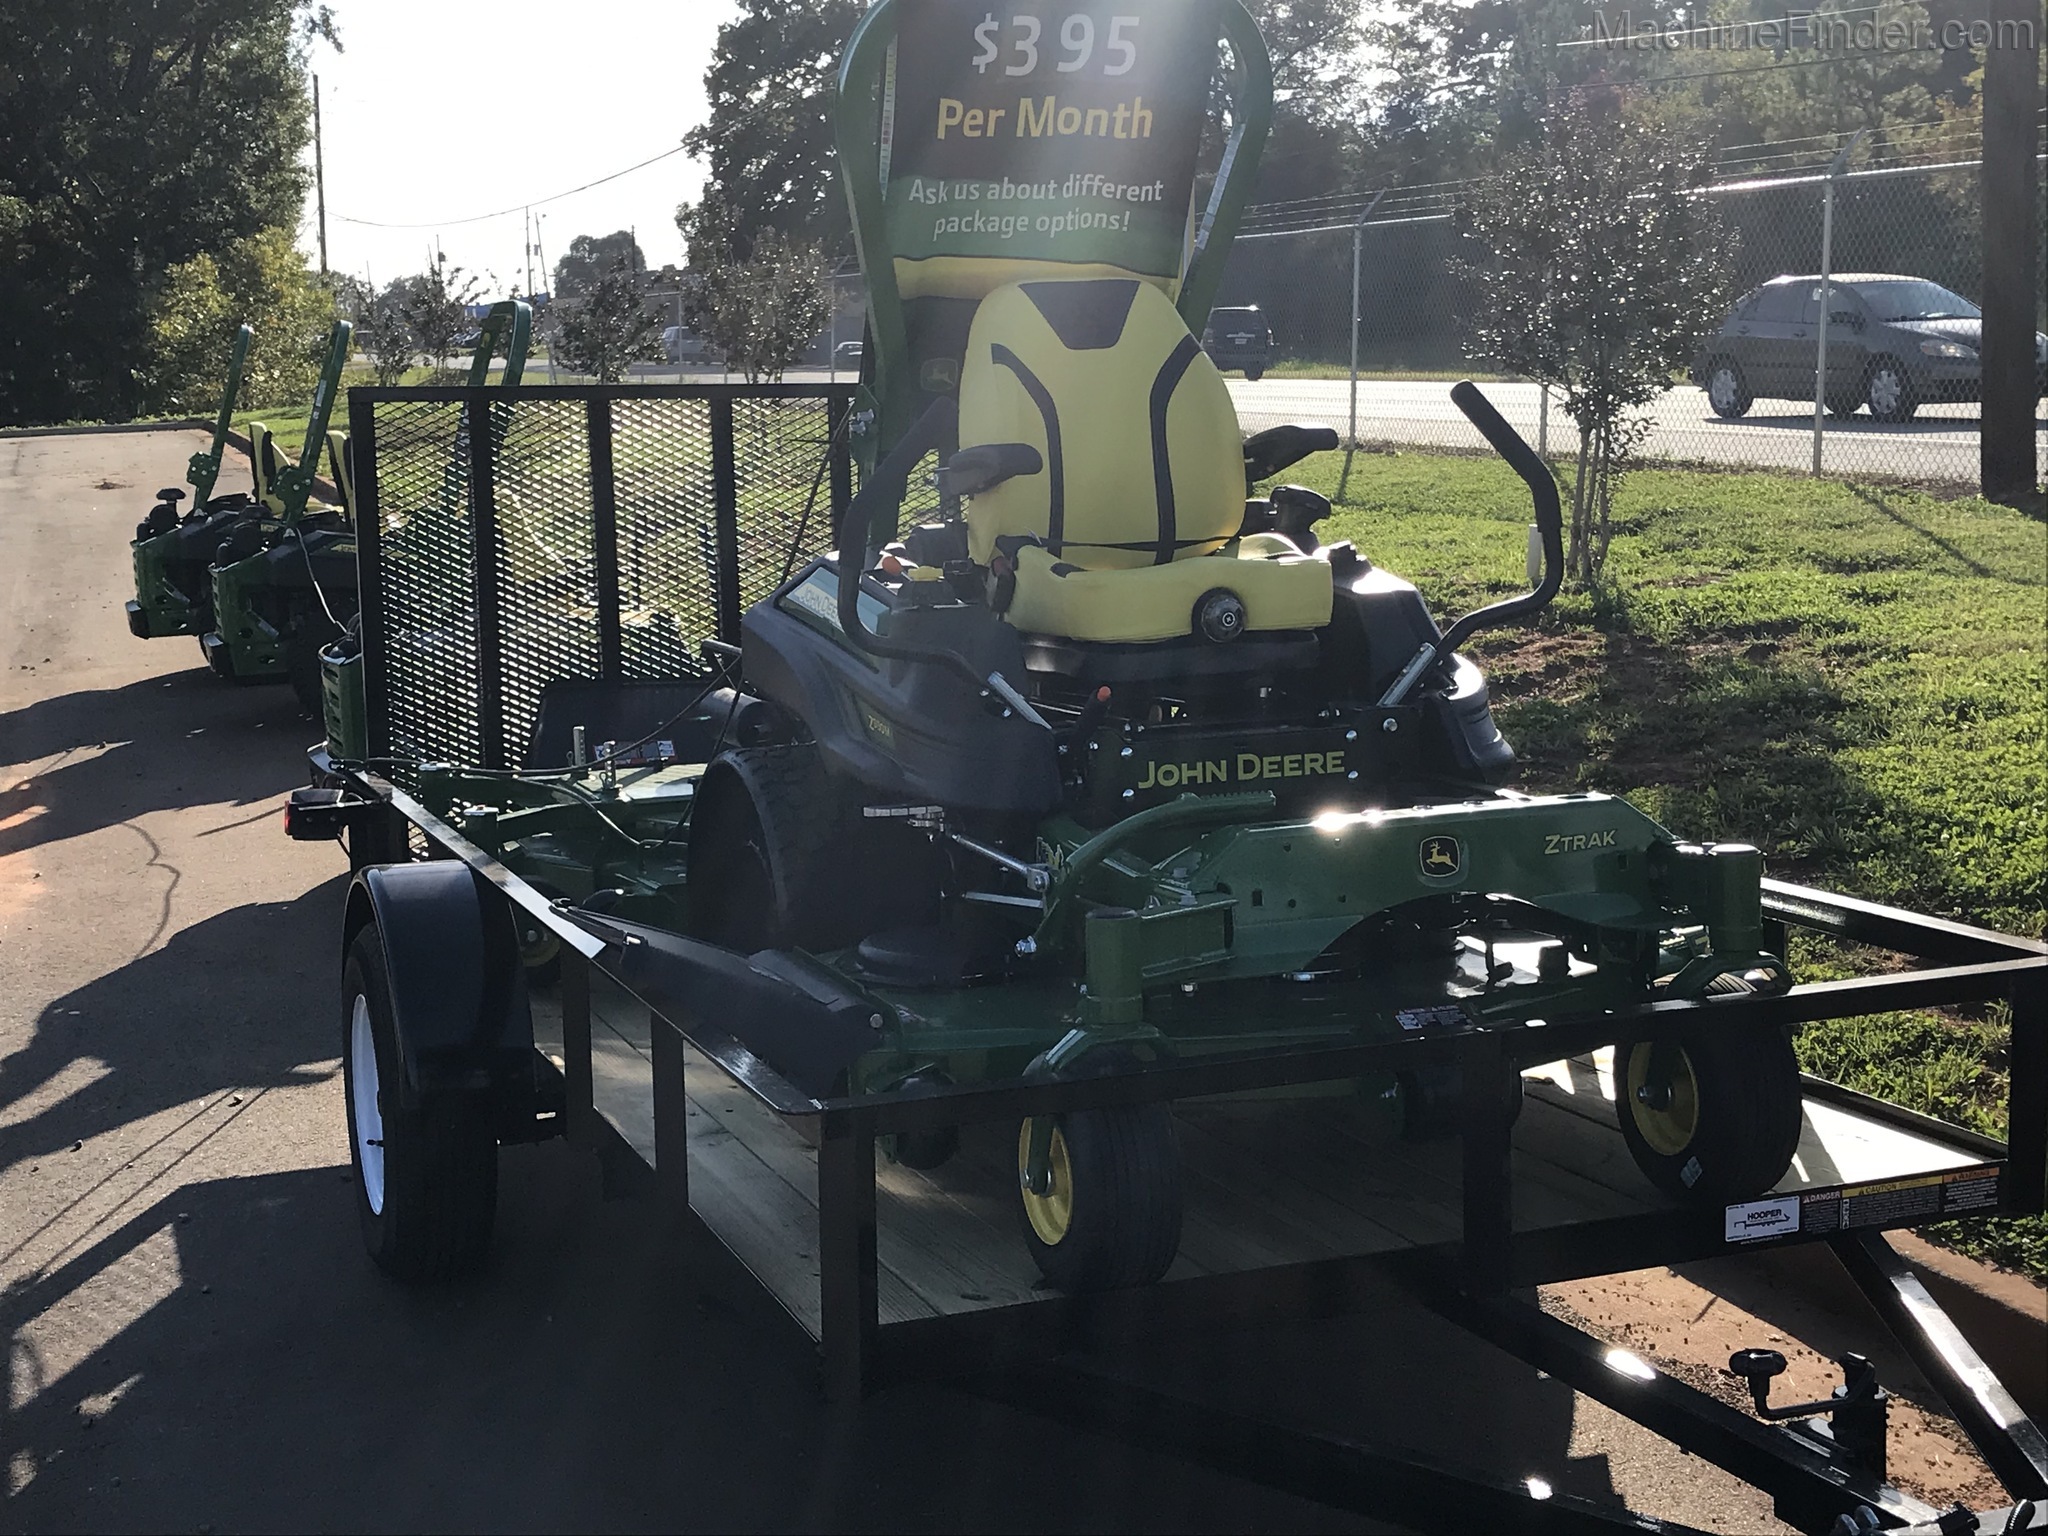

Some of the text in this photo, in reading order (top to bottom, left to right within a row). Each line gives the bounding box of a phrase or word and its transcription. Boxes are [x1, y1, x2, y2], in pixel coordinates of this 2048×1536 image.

[972, 12, 1141, 77] $395
[936, 96, 1153, 140] Per Month
[908, 174, 1163, 205] Ask us about different
[932, 207, 1130, 242] package options!
[1137, 751, 1346, 790] JOHN DEERE
[1543, 830, 1617, 855] ZTRAK
[1810, 1190, 1841, 1202] DANGER
[1865, 1183, 1897, 1194] CAUTION
[1747, 1209, 1782, 1220] HOOPER
